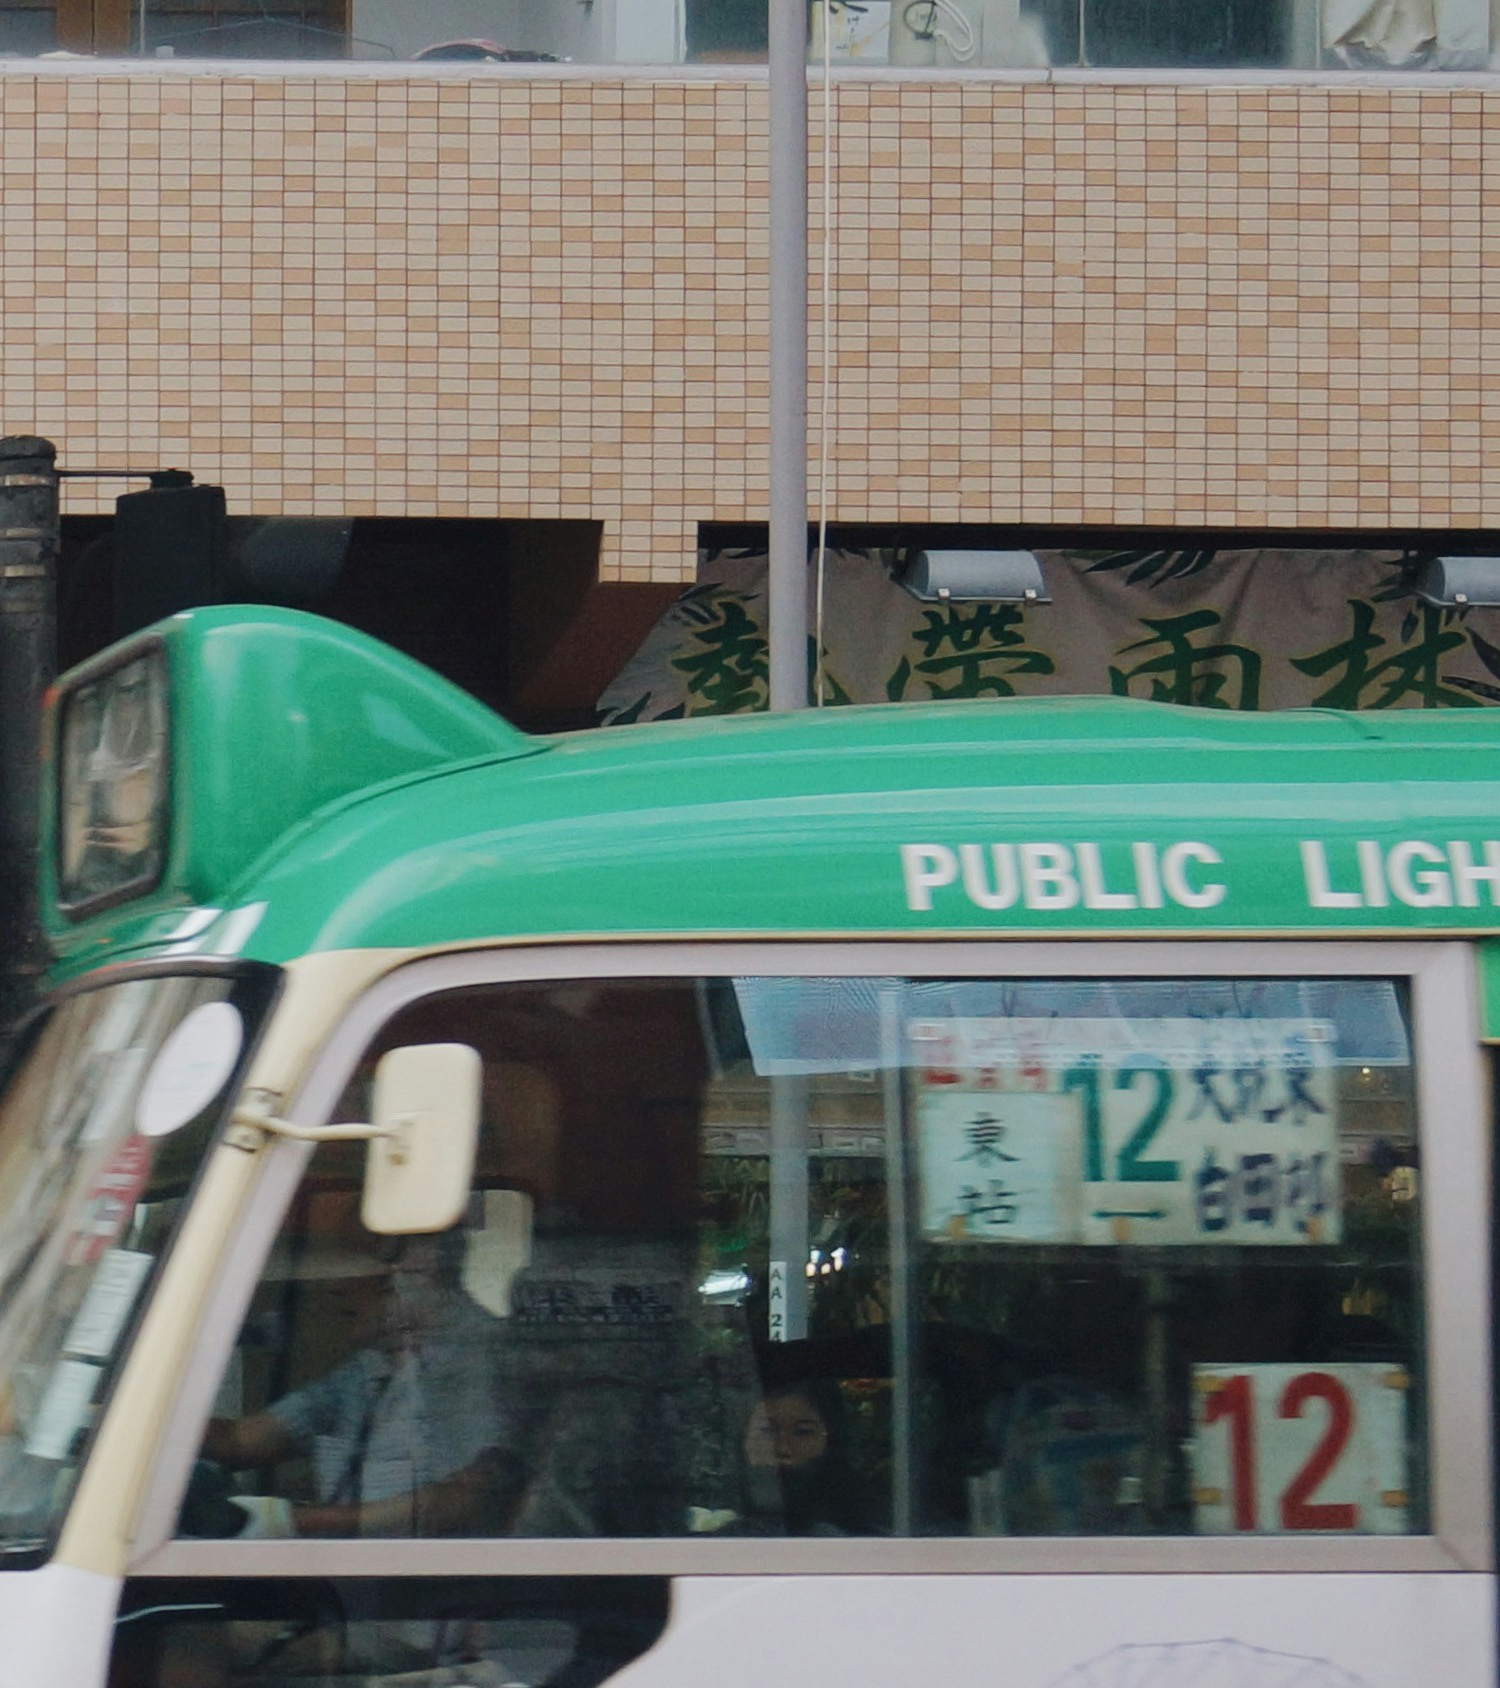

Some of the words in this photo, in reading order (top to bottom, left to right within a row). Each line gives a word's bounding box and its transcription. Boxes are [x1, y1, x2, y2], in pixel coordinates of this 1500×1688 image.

[901, 841, 1228, 911] PUBLIC
[1062, 1051, 1181, 1182] 12
[1201, 1371, 1358, 1531] 12
